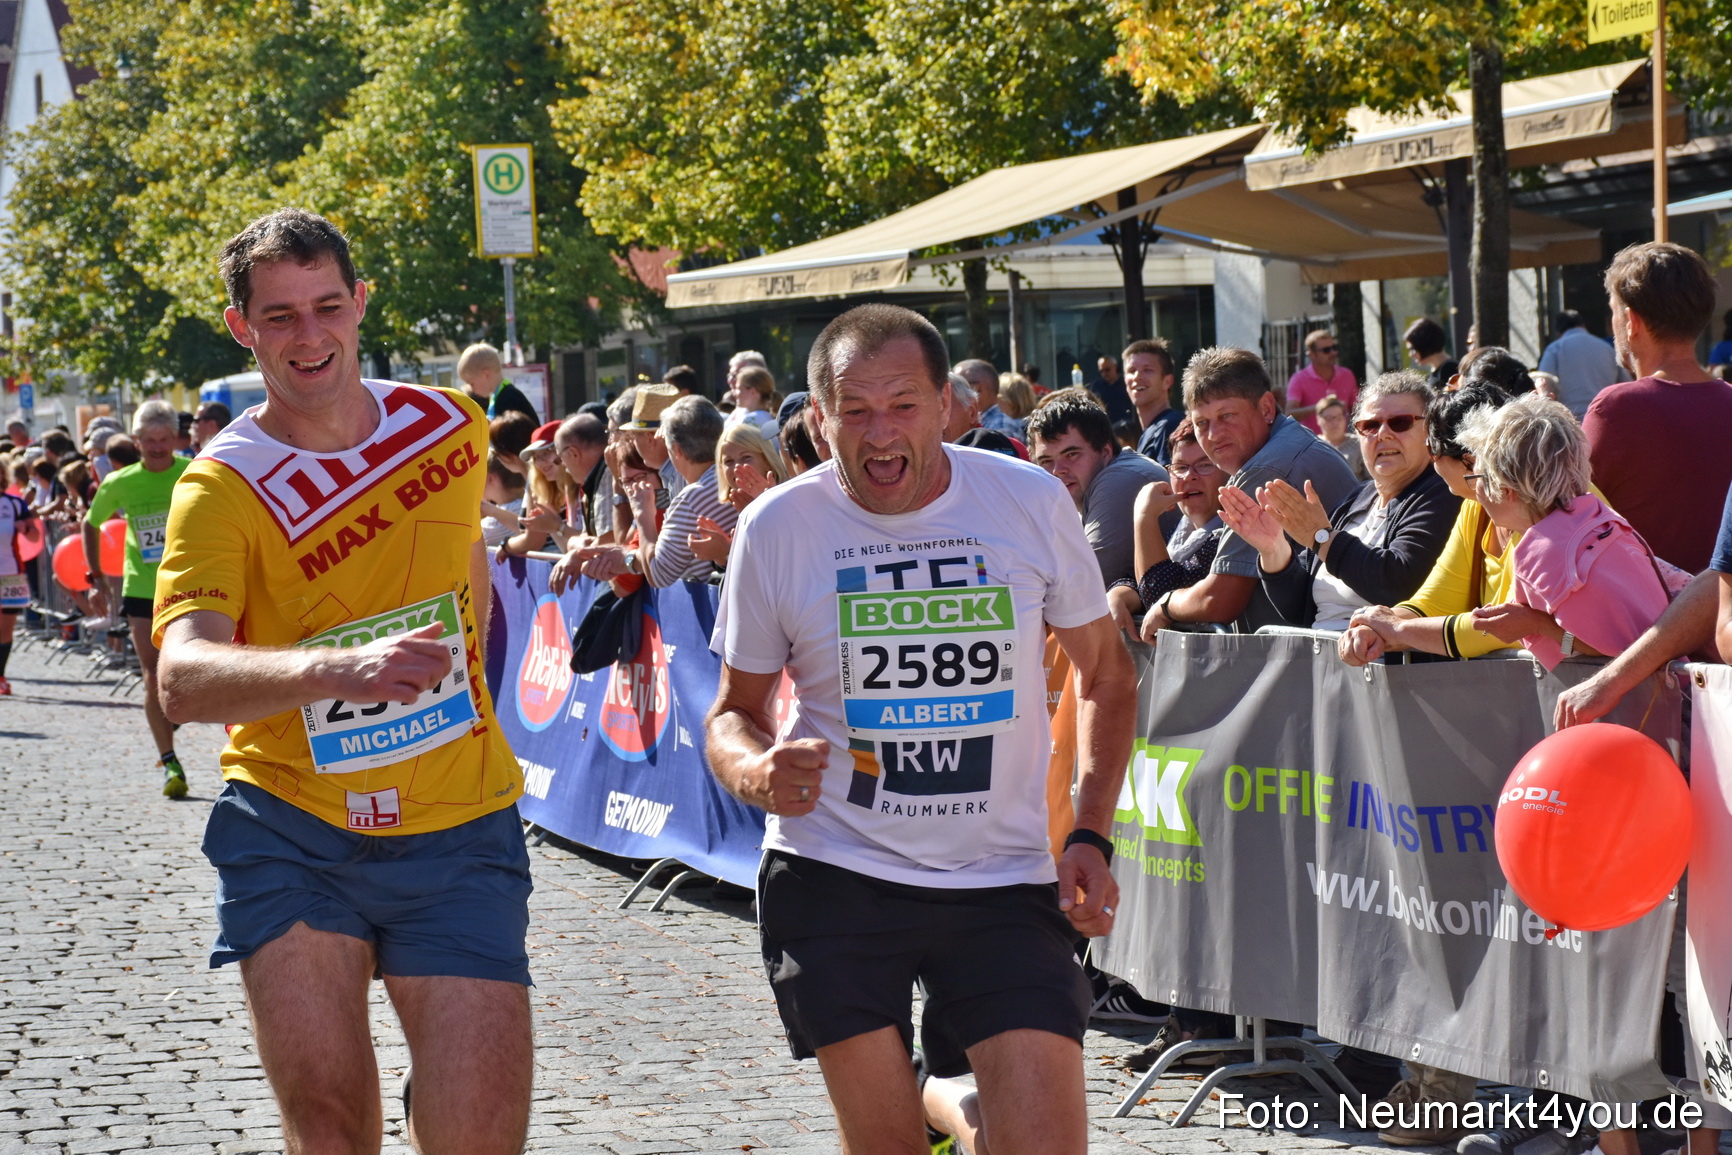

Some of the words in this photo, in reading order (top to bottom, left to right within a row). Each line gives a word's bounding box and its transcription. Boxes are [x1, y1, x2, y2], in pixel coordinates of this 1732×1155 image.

[1601, 0, 1654, 25] Toiletten
[297, 503, 394, 582] MAX
[394, 441, 480, 512] BÖGL
[143, 530, 165, 546] 24
[834, 548, 855, 560] DIE
[861, 543, 892, 556] NEUE
[898, 537, 982, 552] WOHNFORMEL
[852, 592, 1003, 631] BOCK
[524, 624, 571, 702] Hervis
[861, 640, 999, 689] 2589
[879, 701, 983, 725] ALBERT
[340, 708, 450, 755] MICHAEL
[880, 800, 988, 817] RAUMWERK
[1522, 801, 1564, 815] energie
